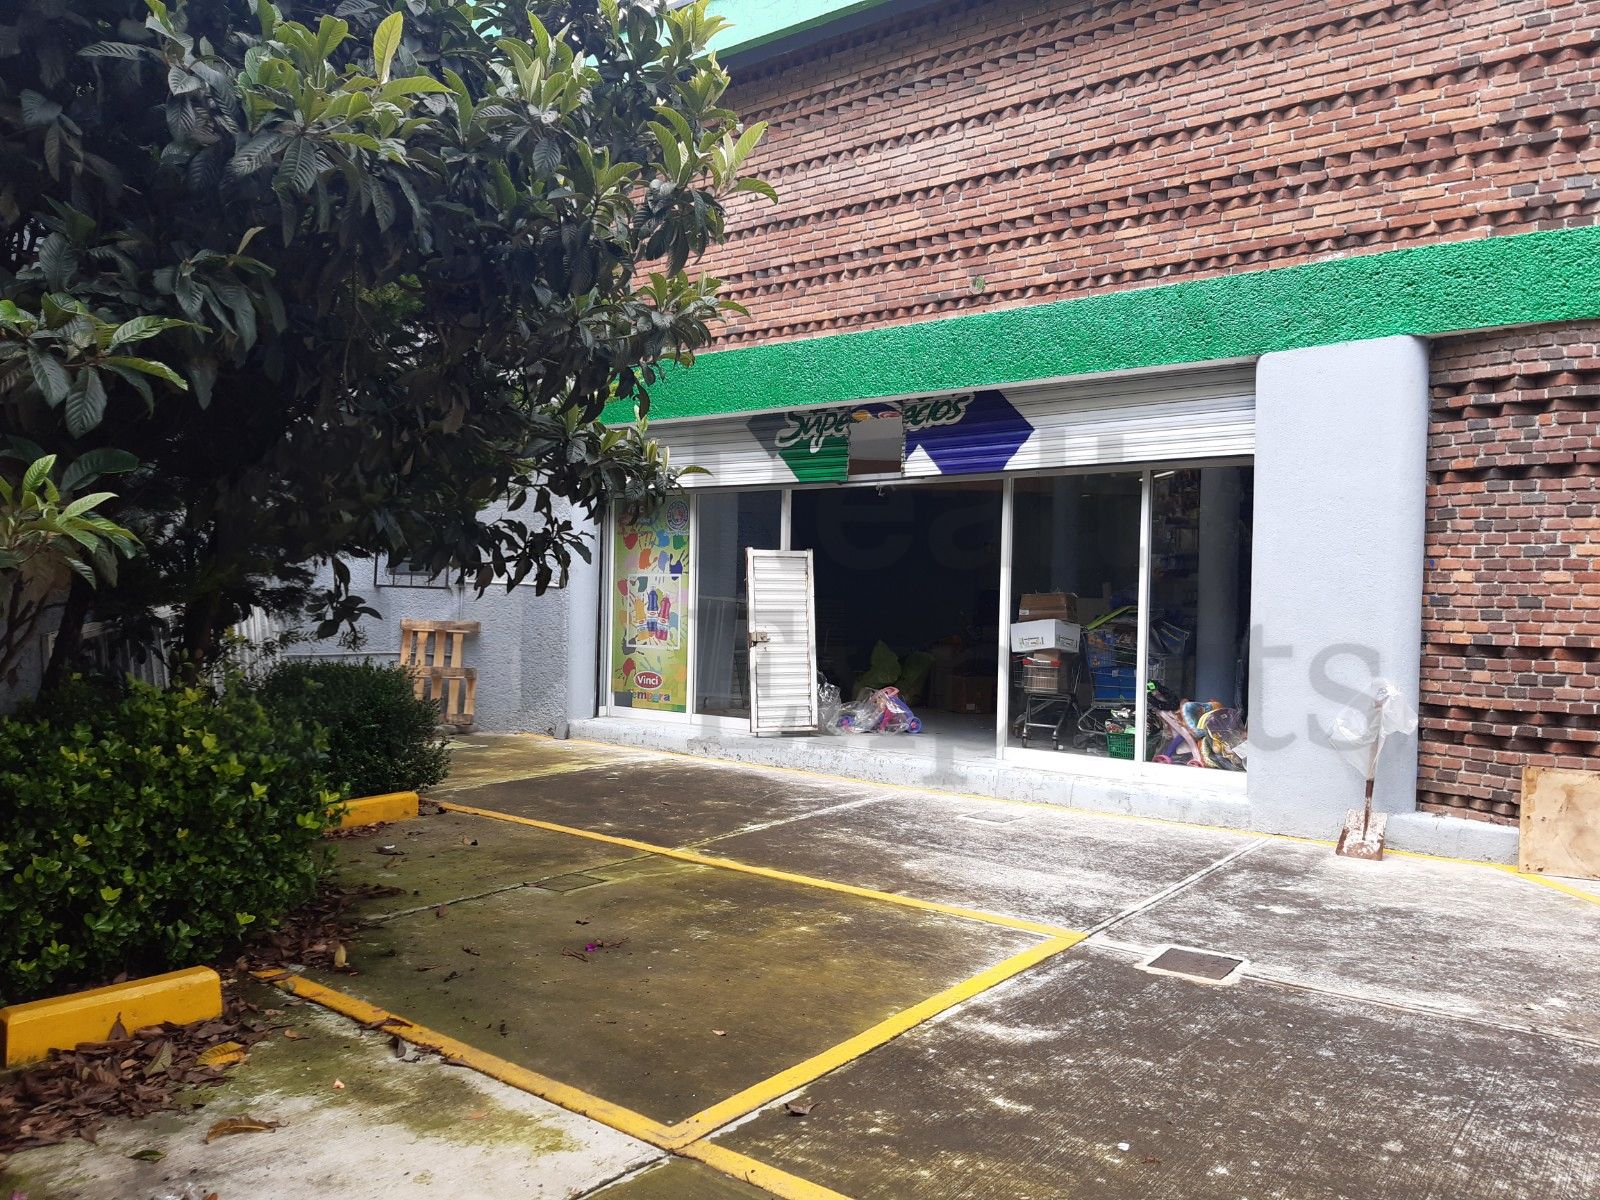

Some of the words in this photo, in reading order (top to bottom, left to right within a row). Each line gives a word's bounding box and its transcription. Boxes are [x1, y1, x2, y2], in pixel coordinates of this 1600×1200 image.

[776, 410, 850, 449] Supe
[901, 394, 971, 427] ecios
[637, 675, 659, 686] Vinci
